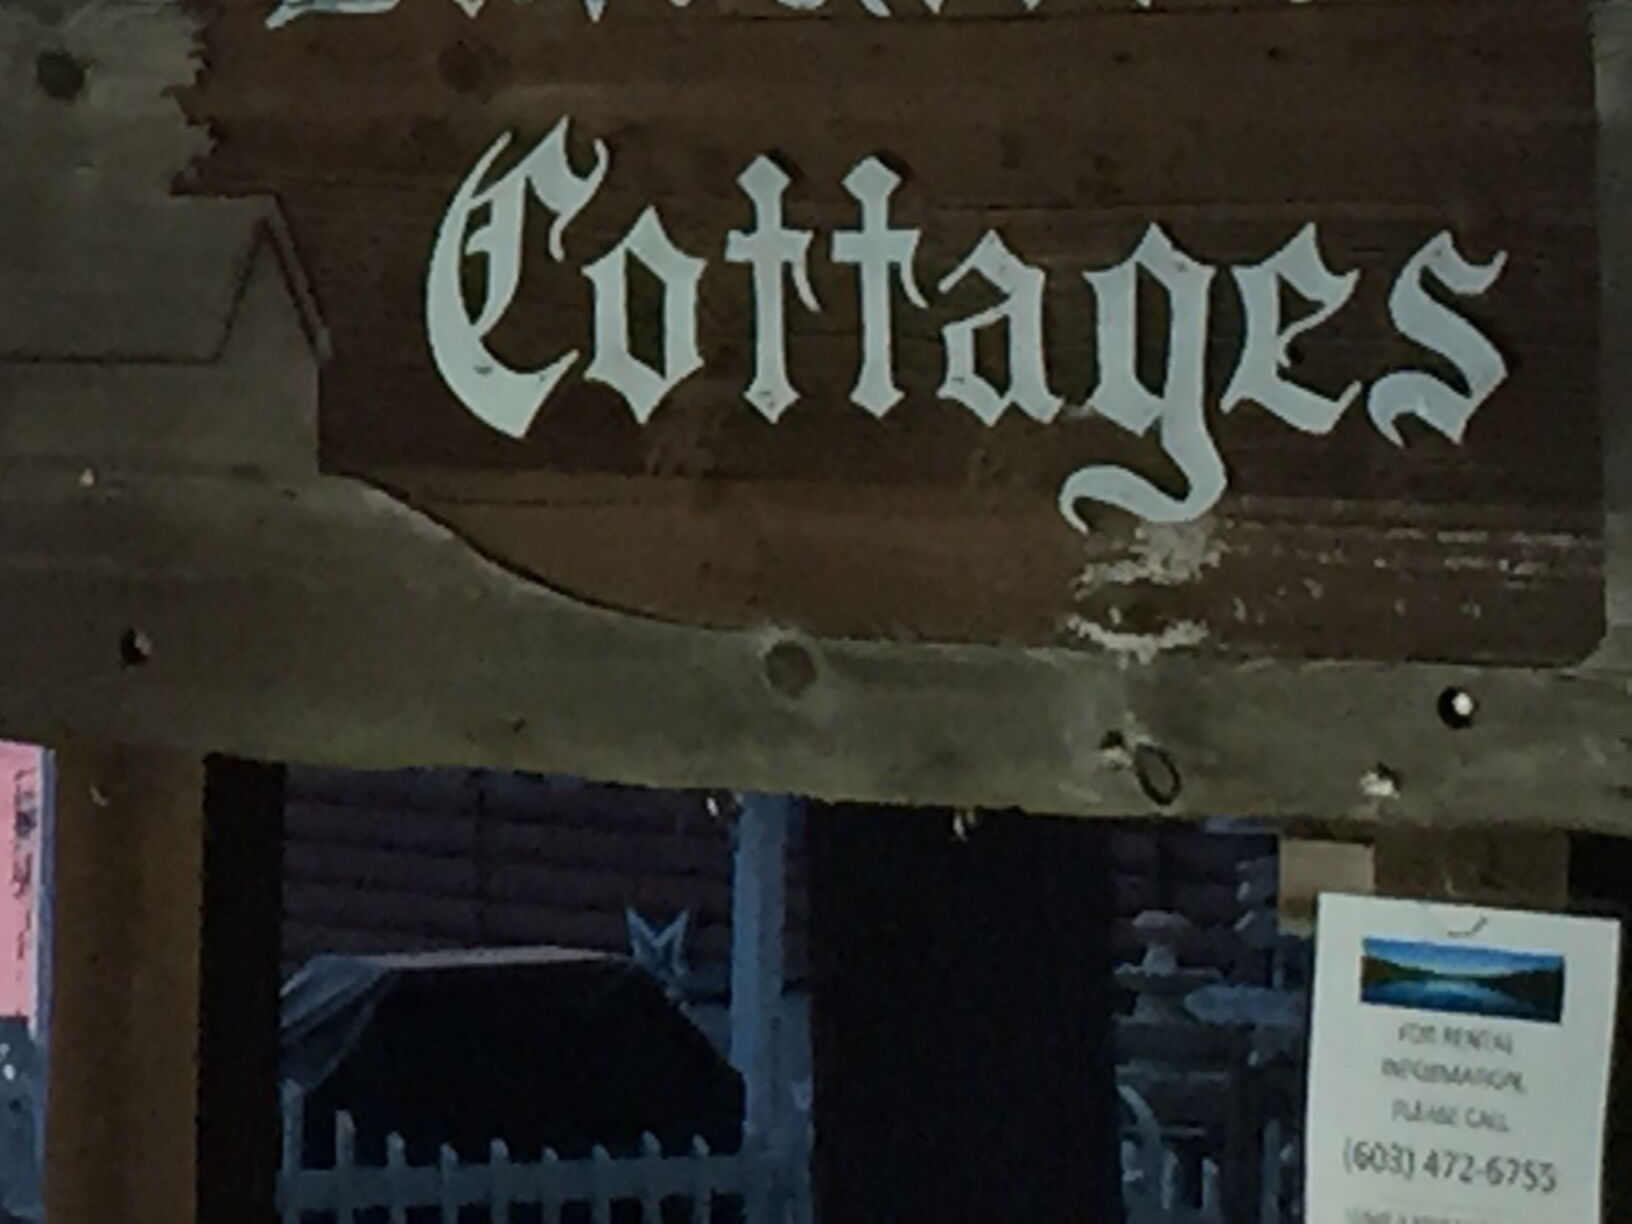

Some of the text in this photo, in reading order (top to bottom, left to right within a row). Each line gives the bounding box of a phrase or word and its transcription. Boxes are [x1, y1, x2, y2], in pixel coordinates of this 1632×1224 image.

[425, 114, 1508, 532] Cottages
[1397, 1024, 1436, 1044] FOR
[1392, 1100, 1511, 1132] PLEASE CALL
[1343, 1138, 1416, 1179] (603)
